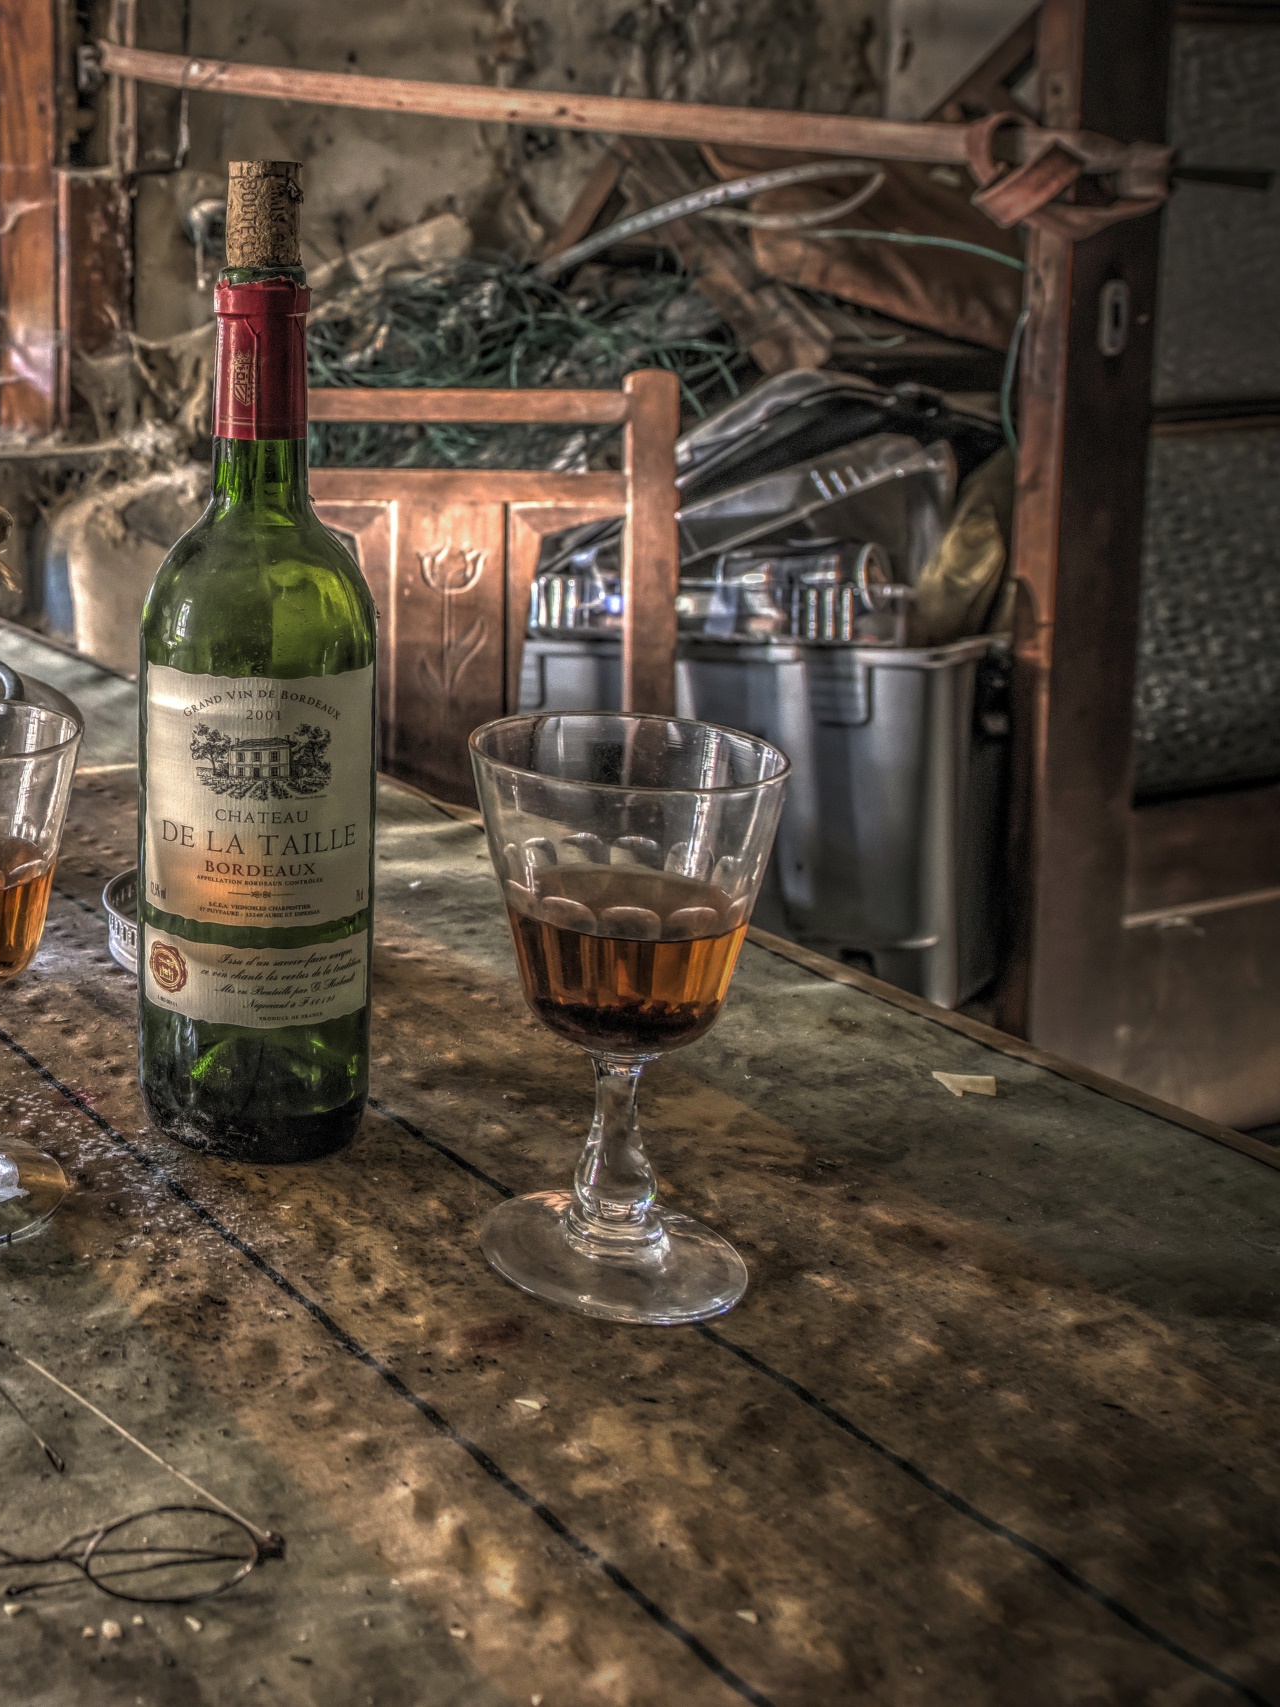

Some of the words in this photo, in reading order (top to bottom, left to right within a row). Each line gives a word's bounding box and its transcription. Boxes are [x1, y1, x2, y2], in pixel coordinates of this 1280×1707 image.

[183, 695, 222, 717] GRAND
[226, 690, 253, 700] VIN
[258, 690, 276, 699] DE
[281, 690, 342, 720] BORDEAUX
[246, 709, 282, 721] 2001
[215, 809, 309, 824] CHATEAU
[162, 819, 195, 848] DE
[207, 830, 245, 855] LA
[257, 823, 356, 856] TAILLE
[205, 860, 317, 877] BORDEAUX
[196, 874, 242, 886] APPELLATION
[245, 879, 282, 887] BORDEAUX
[231, 903, 267, 912] VIGNOBLES
[268, 903, 311, 912] CHARPENTIER
[218, 953, 243, 966] Issu
[246, 956, 269, 967] d'un
[273, 950, 327, 968] savoir-faire
[212, 969, 227, 979] vin
[231, 970, 264, 981] chante
[266, 970, 278, 981] les
[281, 969, 309, 980] vertus
[311, 966, 322, 978] de
[323, 963, 331, 976] la
[215, 983, 235, 995] Mis
[290, 986, 308, 998] par
[301, 1011, 323, 1019] FRANCE
